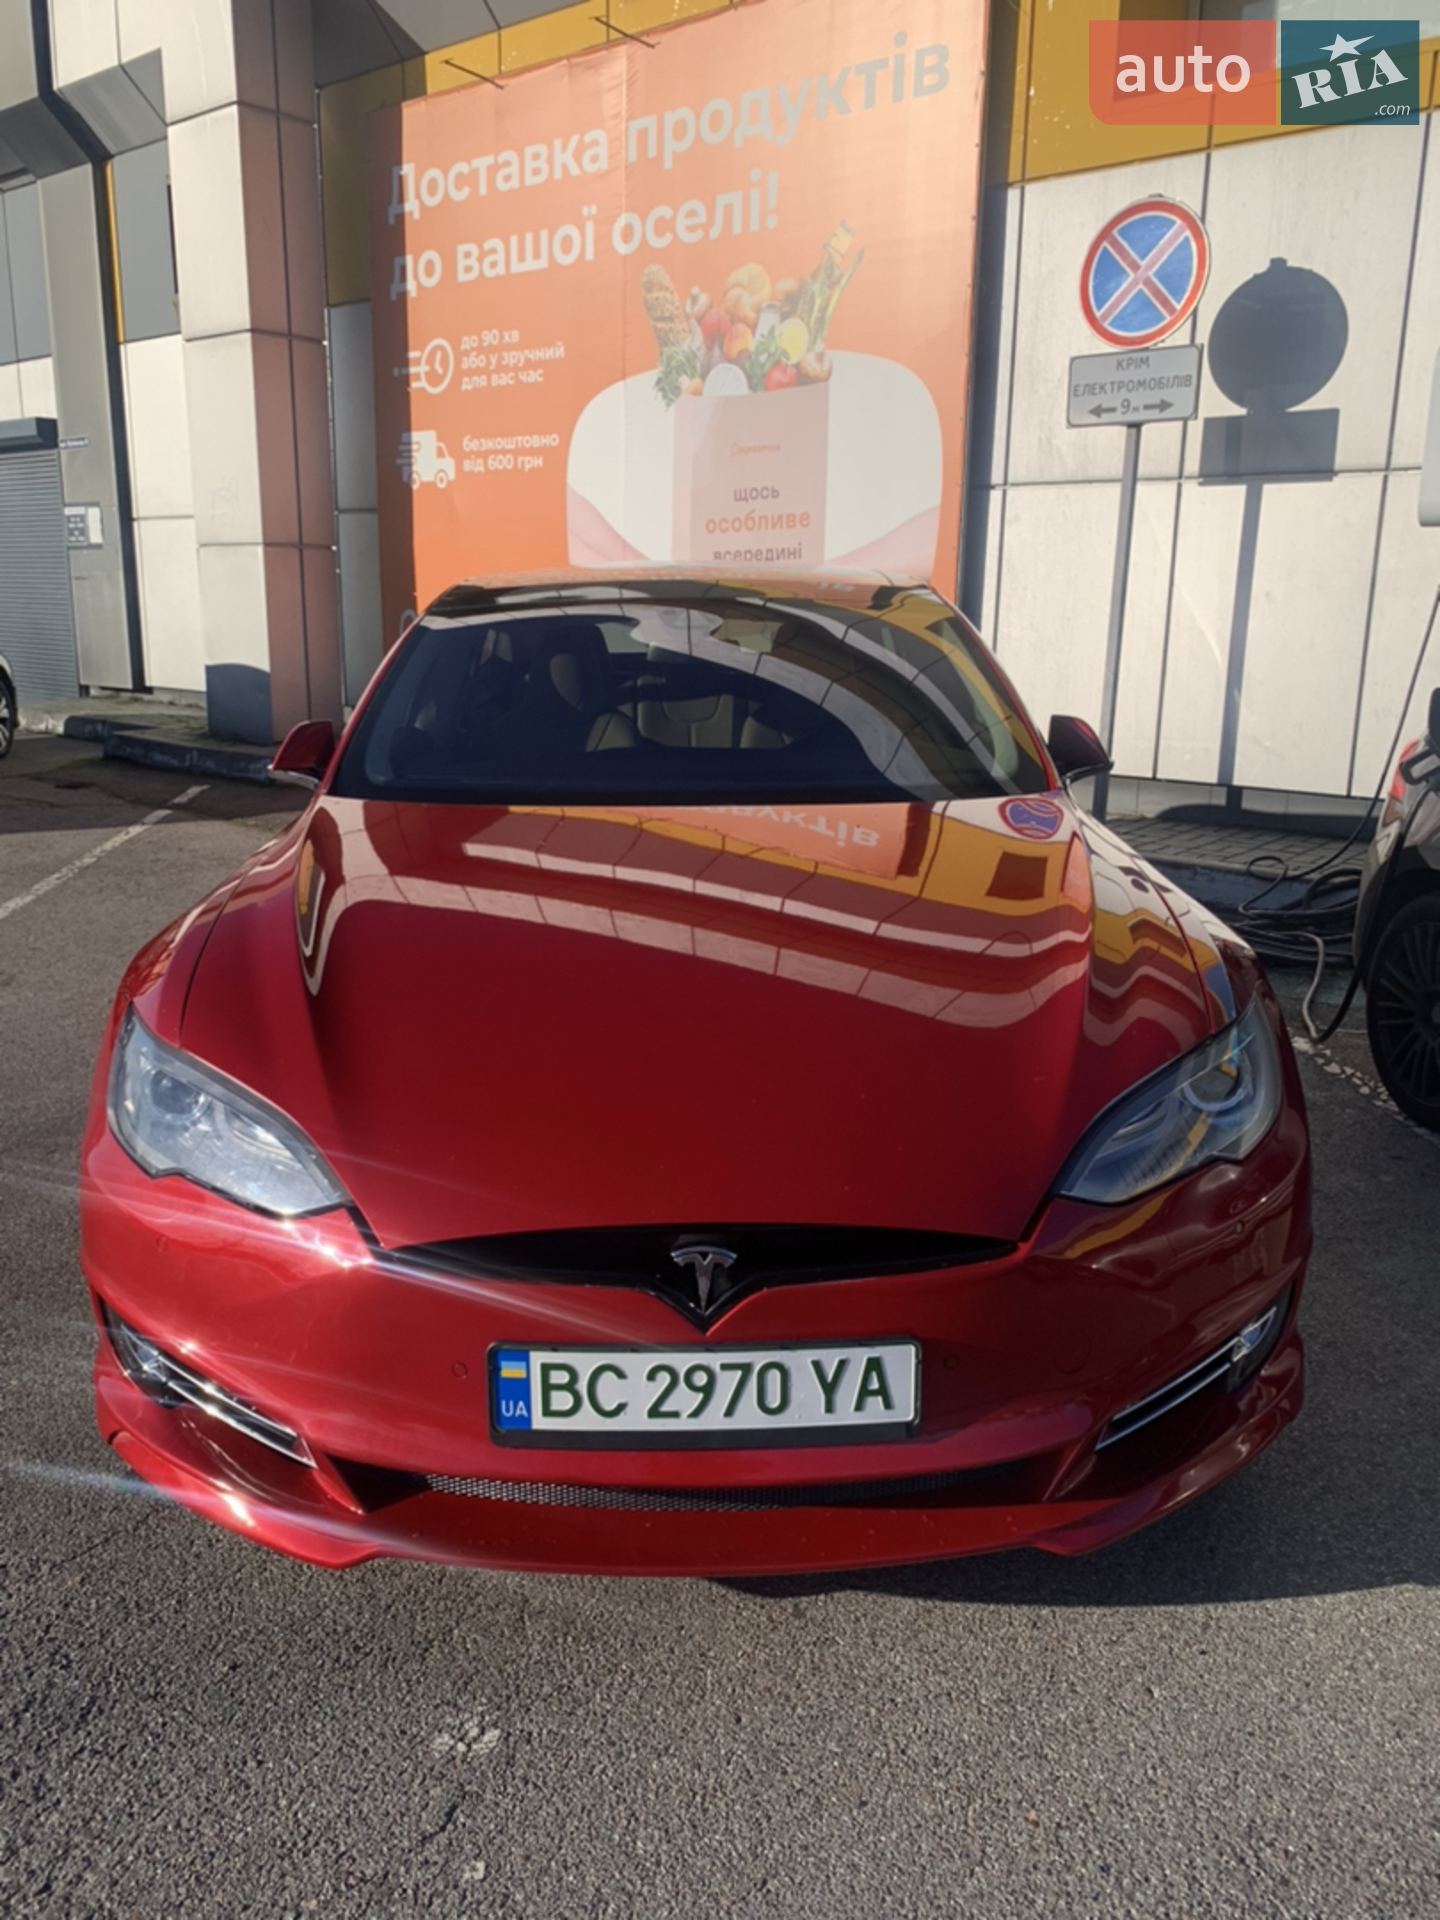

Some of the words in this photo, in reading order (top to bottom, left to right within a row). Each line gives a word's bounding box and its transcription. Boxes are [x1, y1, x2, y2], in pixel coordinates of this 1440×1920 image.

[387, 127, 609, 226] Доставка
[626, 31, 951, 171] продуктів
[390, 249, 443, 302] до
[456, 204, 598, 283] вашої
[611, 168, 779, 256] оселі!
[460, 335, 479, 351] до
[481, 328, 500, 347] 90
[502, 329, 520, 344] хв
[461, 351, 487, 370] або
[489, 352, 499, 370] у
[501, 341, 565, 368] зручний
[1116, 356, 1150, 371] КРІМ
[461, 374, 488, 391] для
[491, 372, 515, 387] вас
[518, 369, 544, 384] час
[1073, 374, 1193, 397] ЕЛЕКТРОМОБІЛІВ
[462, 433, 559, 452] безкоштовно
[463, 454, 485, 473] від
[487, 454, 515, 470] 600
[517, 455, 543, 473] грн
[733, 485, 780, 503] щось
[704, 508, 811, 534] особливе
[713, 542, 803, 561] всередині
[540, 1361, 629, 1419] BC
[645, 1361, 789, 1419] 2970
[810, 1356, 896, 1415] YA
[501, 1401, 529, 1418] UA
